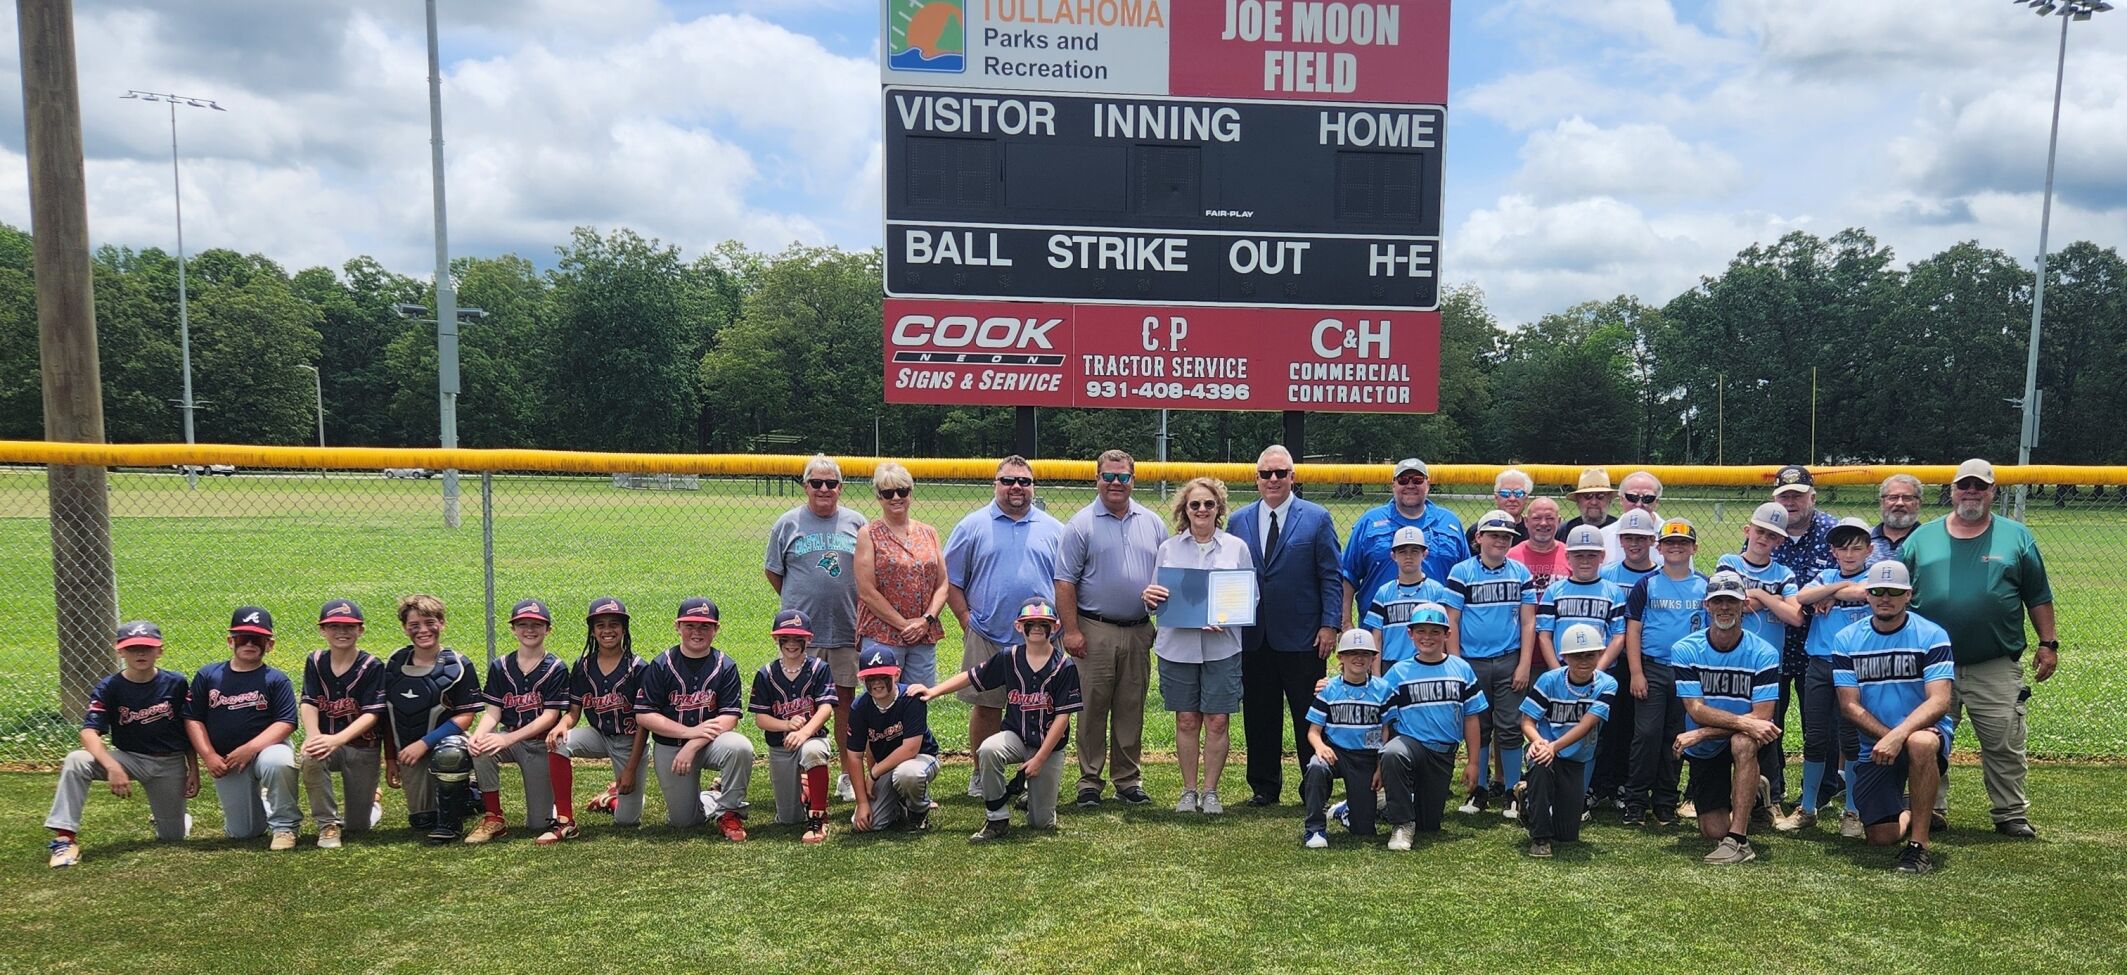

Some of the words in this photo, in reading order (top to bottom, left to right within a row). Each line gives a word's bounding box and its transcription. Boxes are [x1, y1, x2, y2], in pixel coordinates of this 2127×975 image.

[1221, 0, 1283, 42] JOE
[1292, 1, 1400, 46] MOON
[984, 27, 1049, 50] Parks
[1057, 32, 1099, 51] and
[984, 56, 1108, 80] Recreation
[1264, 51, 1357, 94] FIELD
[894, 95, 1056, 136] VISITOR
[1094, 103, 1241, 142] INNING
[1319, 111, 1436, 149] HOME
[1205, 210, 1254, 219] FAIR-PLAY
[906, 230, 1012, 267] BALL
[1047, 234, 1189, 273] STRIKE
[1228, 239, 1311, 275] OUT
[1369, 244, 1432, 278] H-E
[891, 315, 1064, 349] COOK
[1142, 316, 1188, 352] C.P.
[1311, 318, 1391, 359] C&H
[919, 353, 1039, 364] NEON
[1082, 354, 1165, 377] TRACTOR
[1171, 357, 1248, 379] SERVICE
[960, 373, 974, 390] &
[1289, 362, 1410, 382] COMMERCIAL
[1086, 381, 1250, 400] 931-408-4396
[1288, 384, 1410, 404] CONTRACTOR
[1471, 583, 1504, 602] HAWKS
[1557, 599, 1590, 617] HAWKS
[1853, 655, 1892, 680] HAWKS
[1894, 654, 1917, 677] DEN
[1408, 682, 1443, 703] HAWKS
[1732, 675, 1751, 697] DEN
[1330, 706, 1361, 724] HAWKS
